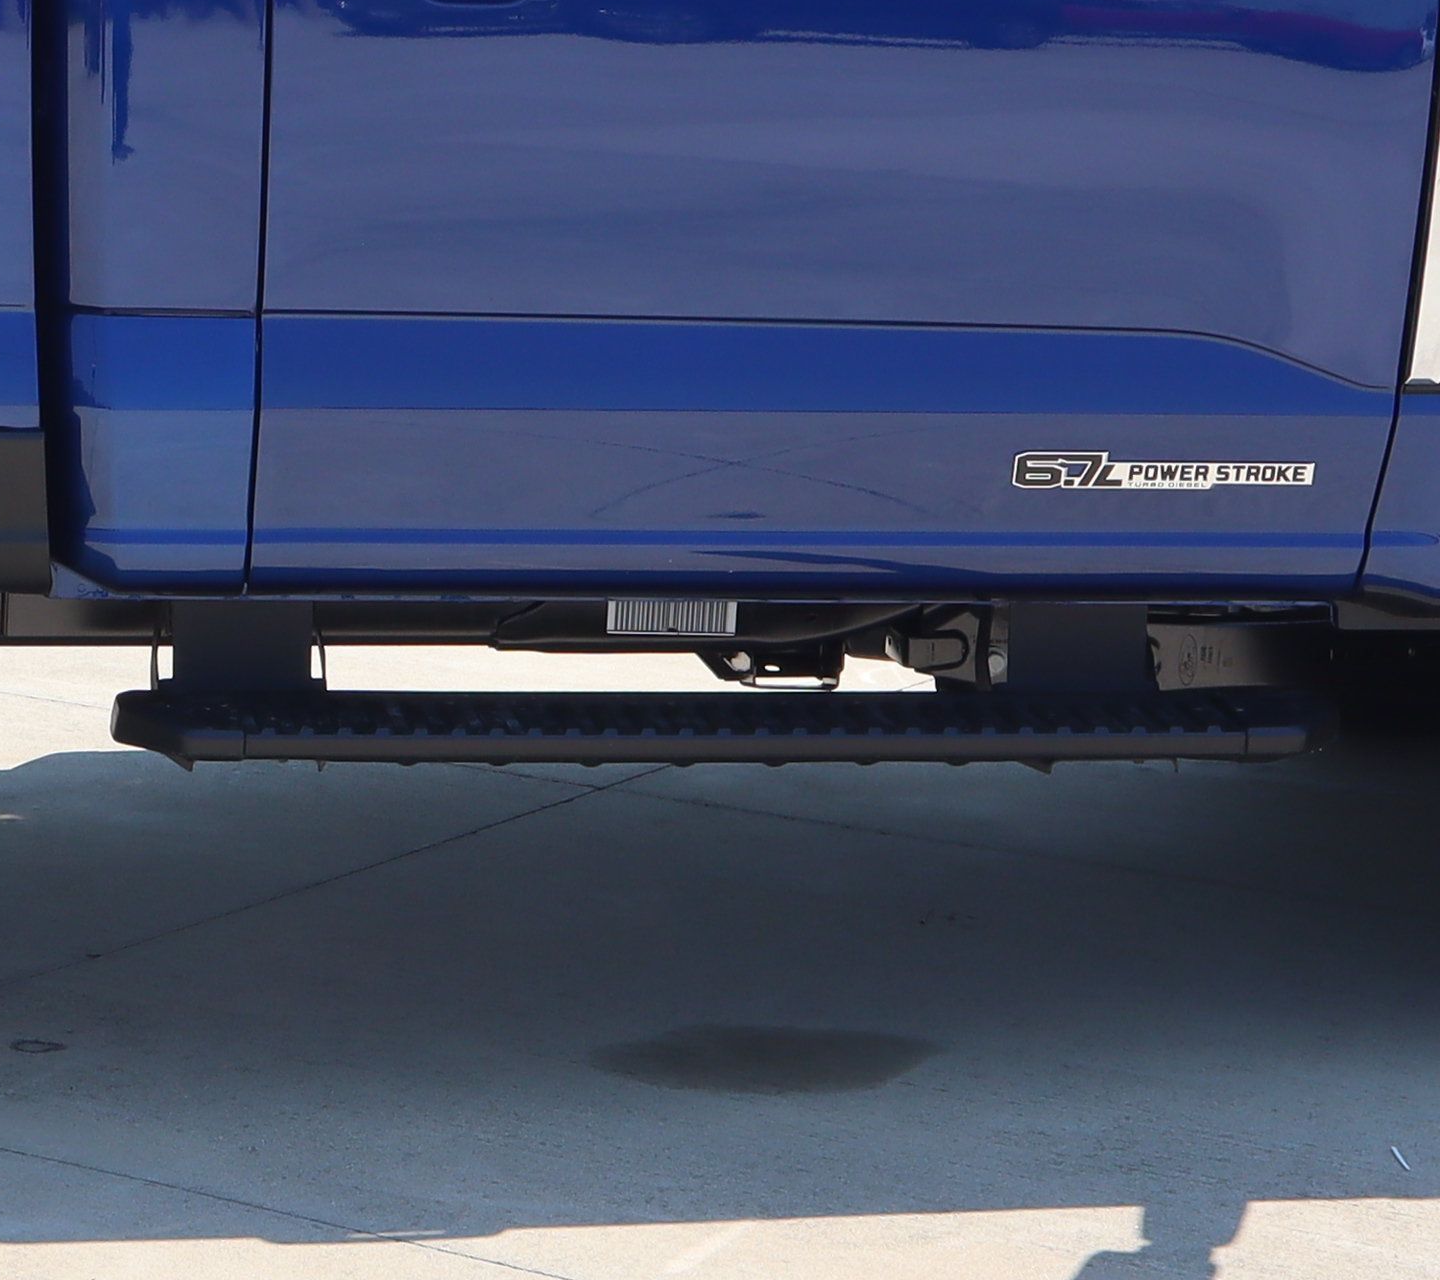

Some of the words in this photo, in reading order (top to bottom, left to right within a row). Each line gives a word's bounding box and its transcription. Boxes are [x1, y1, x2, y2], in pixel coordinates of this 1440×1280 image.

[1013, 452, 1123, 488] 6.7L
[1128, 464, 1210, 482] POWER
[1215, 464, 1308, 483] STROKE
